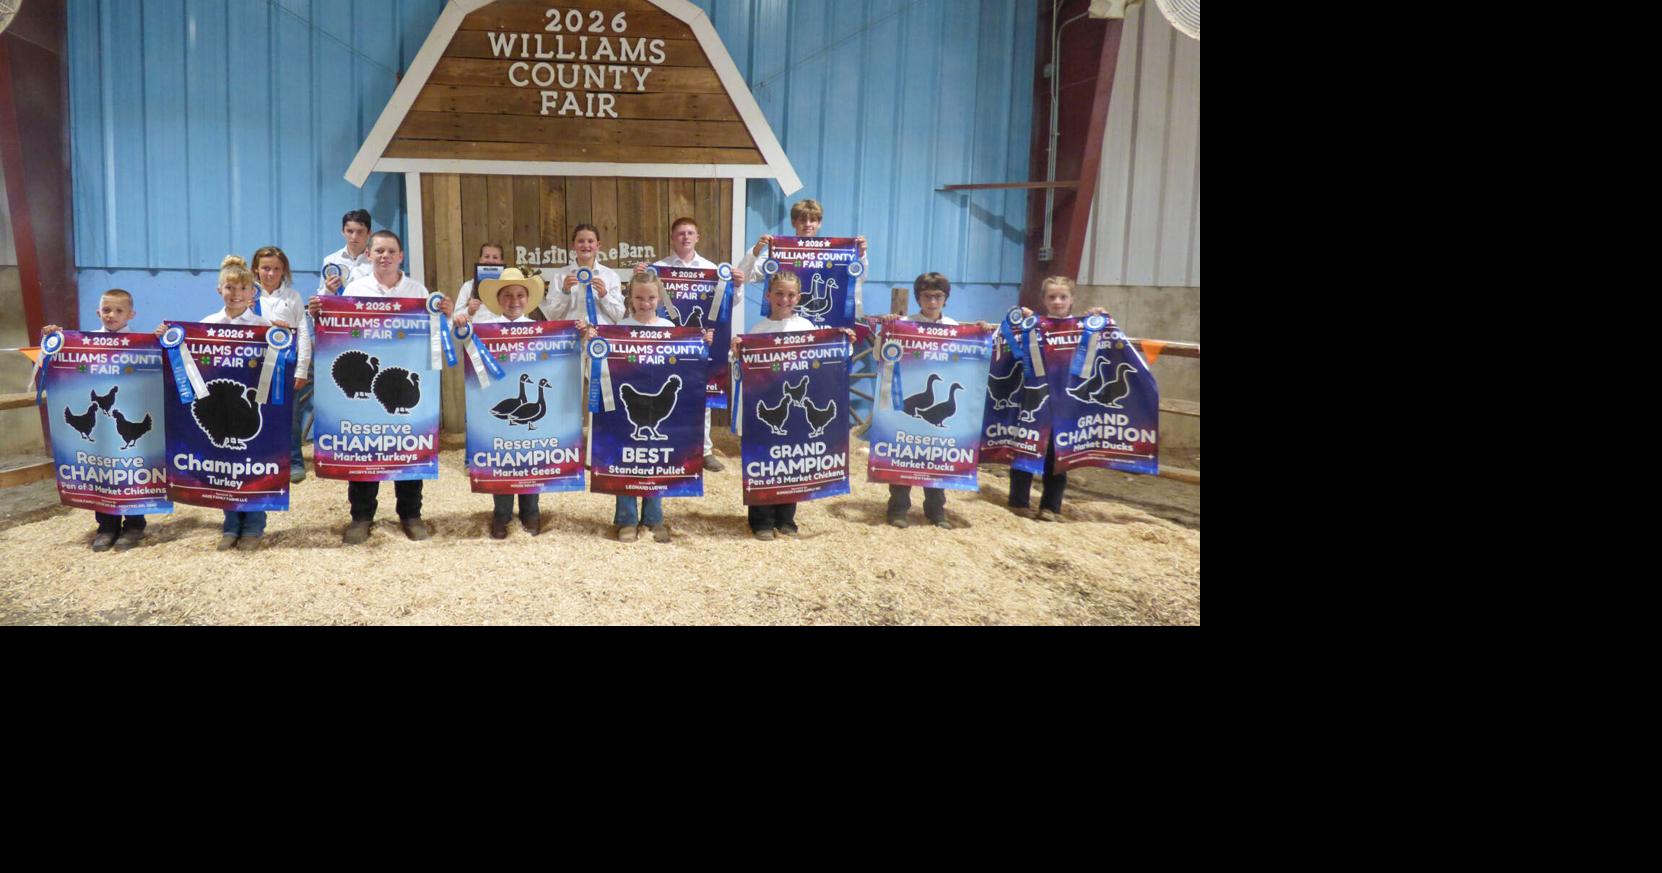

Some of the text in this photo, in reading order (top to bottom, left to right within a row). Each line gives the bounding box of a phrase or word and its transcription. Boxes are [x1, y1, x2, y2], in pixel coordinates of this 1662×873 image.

[545, 8, 627, 33] 2026
[488, 32, 666, 64] WILLIAMS
[508, 62, 652, 91] COUNTY
[540, 91, 618, 118] FAIR
[515, 245, 578, 266] Raising
[618, 242, 656, 259] Barn
[772, 251, 855, 261] WILLIAMS COUNTY
[803, 261, 823, 269] FAIR
[678, 271, 698, 279] 2026
[676, 291, 698, 300] FAIR
[366, 302, 391, 311] 2026
[319, 317, 429, 329] WILLIAMS COUNT
[217, 329, 244, 338] 2026
[363, 329, 392, 339] FAIR
[510, 327, 534, 335] 2026
[640, 330, 663, 339] 2026
[926, 328, 949, 336] 2026
[93, 337, 119, 346] 2026
[489, 340, 576, 353] LIAMS COUNTY
[783, 336, 806, 345] 2026
[1096, 341, 1112, 349] AIR
[190, 344, 268, 357] LIAMS COU
[609, 344, 704, 355] ILLIAMS COUNTY
[941, 343, 988, 355] COUNTY
[510, 353, 537, 362] FAIR
[638, 355, 665, 365] FAIR
[743, 348, 846, 363] WILLIAMS COUNTY
[923, 352, 949, 362] FAIR
[213, 356, 243, 368] FAIR
[783, 361, 809, 371] FAIR
[90, 365, 120, 375] FAIR
[1077, 413, 1129, 428] GRAND
[340, 421, 412, 434] Reserve
[895, 430, 956, 447] Reserve
[1056, 425, 1156, 446] CHAMPION
[318, 434, 433, 452] CHAMPION
[493, 437, 559, 450] Reserve
[1102, 441, 1134, 451] Ducks
[622, 447, 674, 464] BEST
[769, 441, 826, 459] GRAND
[874, 441, 974, 464] CHAMPION
[76, 451, 144, 467] Reserve
[333, 452, 418, 463] Market Turkeys
[473, 447, 580, 467] CHAMPION
[173, 453, 279, 479] Champion
[608, 465, 686, 475] Standard Pullet
[746, 452, 846, 478] CHAMPION
[891, 459, 954, 472] Market Ducks
[59, 464, 167, 485] CHAMPION
[493, 467, 561, 477] Market Geese
[748, 469, 845, 486] Pen of 3 Market Chickens
[61, 482, 76, 490] Pen
[95, 485, 121, 495] Market
[124, 487, 167, 495] Chickens
[207, 475, 243, 490] Turkey
